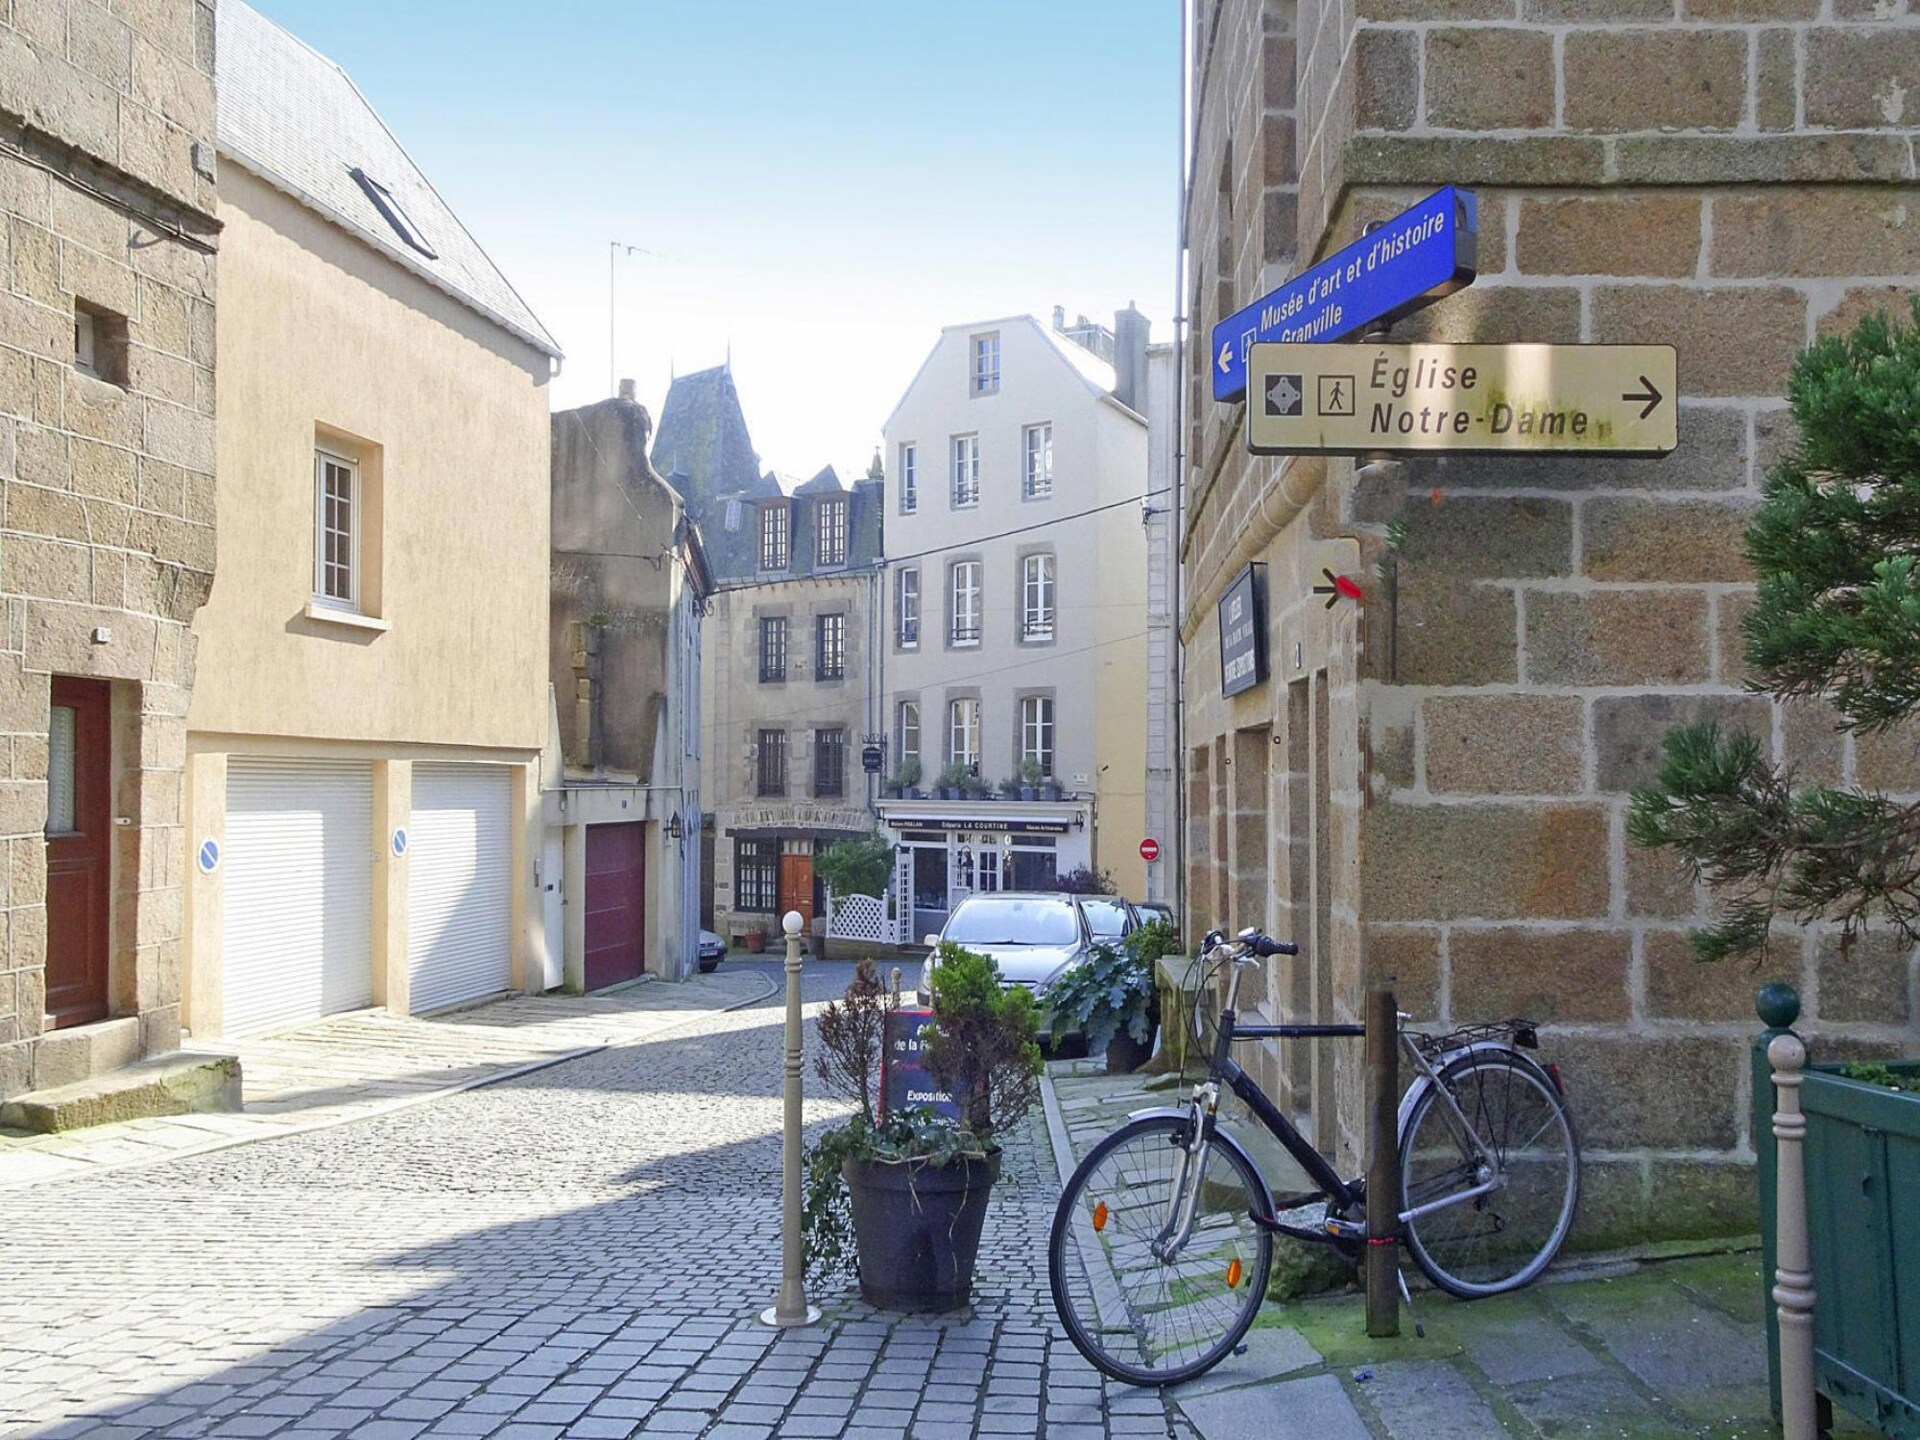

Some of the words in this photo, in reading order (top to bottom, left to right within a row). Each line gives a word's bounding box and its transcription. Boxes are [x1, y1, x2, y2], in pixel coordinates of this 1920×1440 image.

[1260, 292, 1304, 333] Musée
[1308, 267, 1341, 305] d'art
[1346, 257, 1362, 283] et
[1367, 211, 1445, 272] d'histoire
[1281, 303, 1342, 342] Granville
[1370, 351, 1477, 399] Église
[1370, 402, 1588, 435] Notre-Dame
[974, 822, 1008, 830] COURTINE
[908, 1039, 918, 1051] la
